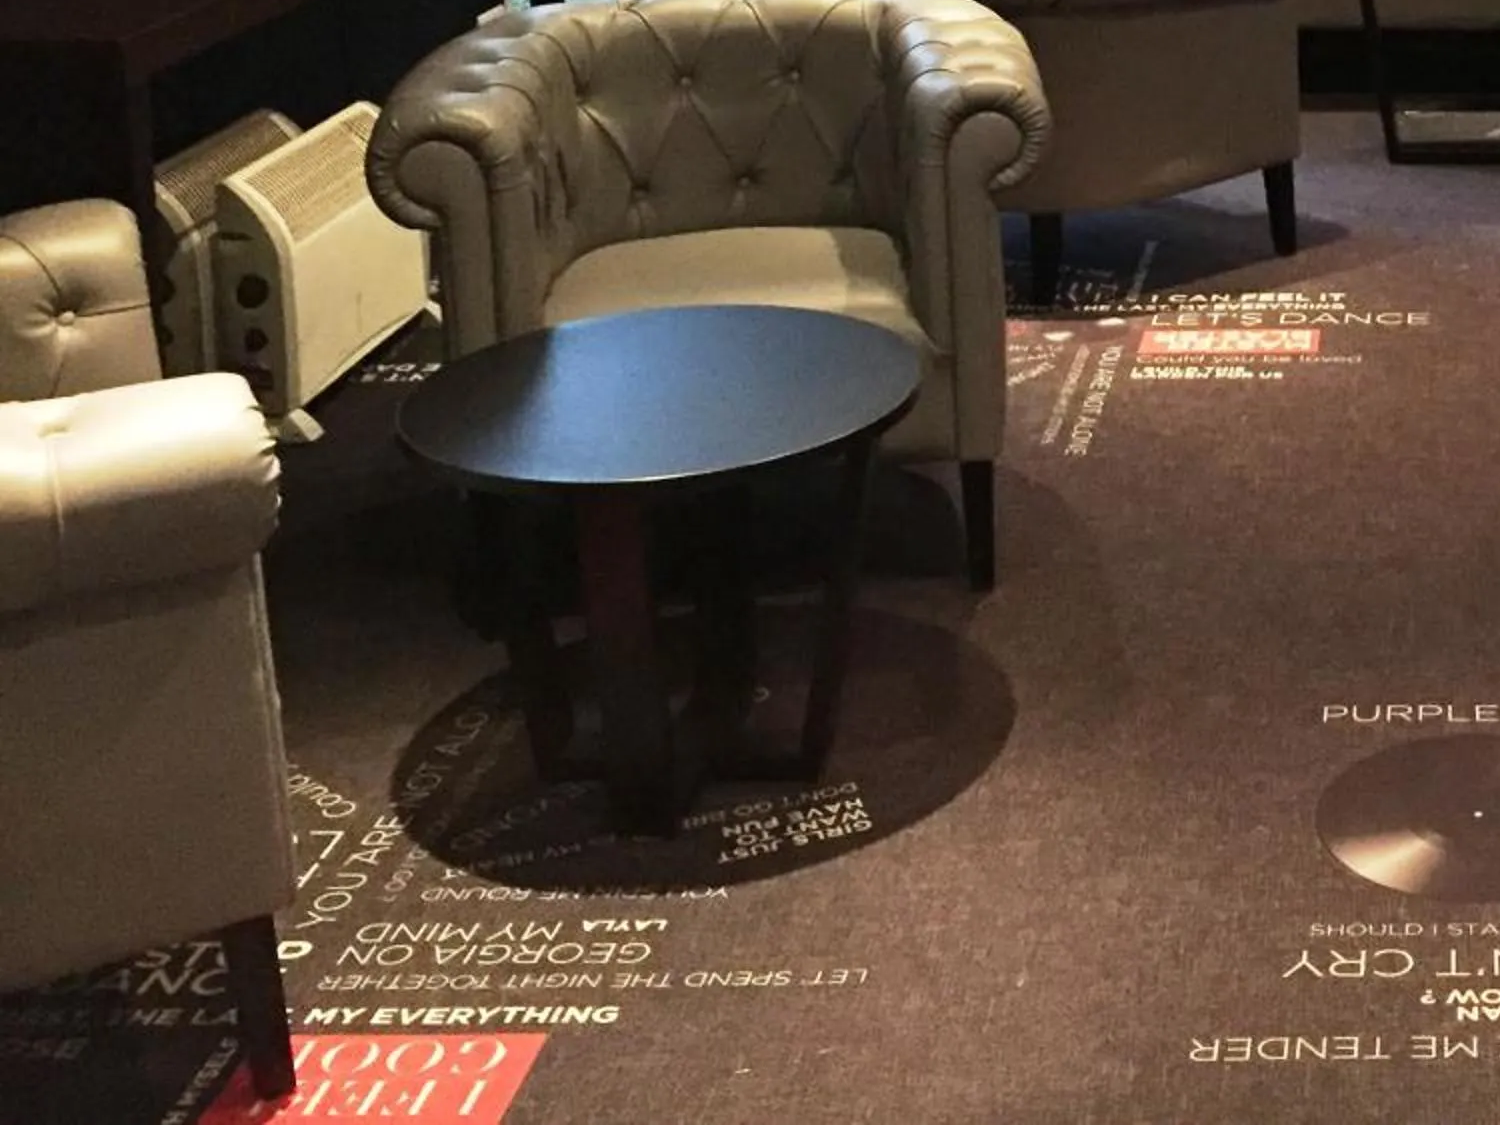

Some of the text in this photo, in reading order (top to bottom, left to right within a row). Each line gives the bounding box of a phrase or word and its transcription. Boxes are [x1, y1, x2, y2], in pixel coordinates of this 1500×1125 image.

[1239, 292, 1311, 303] FEEL
[1151, 311, 1432, 327] LET'S DANCE
[1321, 703, 1500, 724] PURPLE
[717, 818, 873, 865] GIRLS JUST
[294, 871, 368, 930] YOU
[420, 885, 532, 903] ROUND
[355, 920, 564, 943] MY MIND
[582, 919, 669, 933] LAYLA
[1308, 921, 1424, 937] SHOULD
[336, 941, 652, 966] GEORGIA ON
[1281, 948, 1415, 978] CRY
[316, 970, 793, 991] SPEND THE NIGHT TOGETHER
[303, 1005, 622, 1025] MY EVERYTHING
[1188, 1035, 1393, 1063] TENDER
[1410, 1034, 1479, 1059] ME
